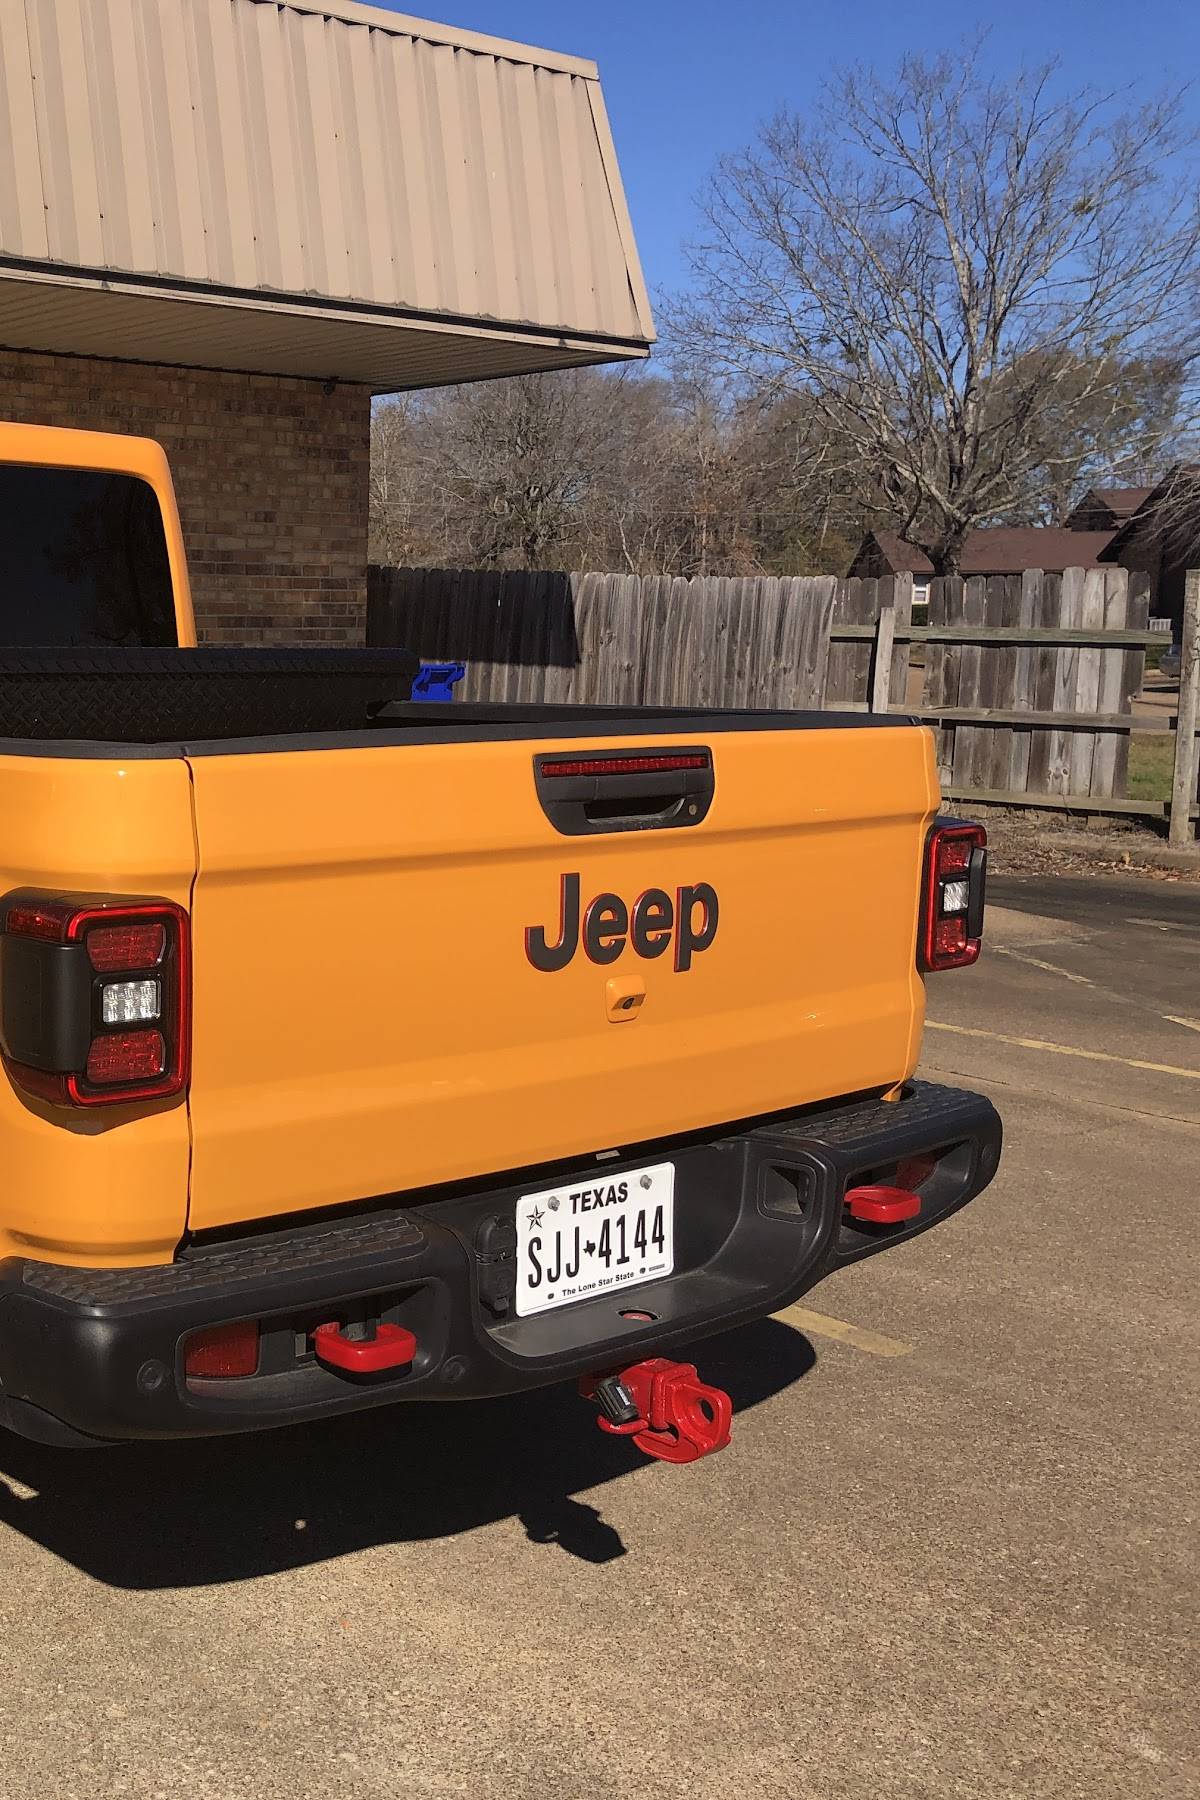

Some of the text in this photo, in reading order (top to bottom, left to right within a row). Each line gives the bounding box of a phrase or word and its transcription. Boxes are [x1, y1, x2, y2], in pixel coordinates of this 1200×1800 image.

[524, 871, 719, 973] Jeep
[569, 1181, 629, 1215] TEXAS
[528, 1205, 665, 1289] SJJ 4144
[562, 1271, 635, 1297] The Lone Star State
